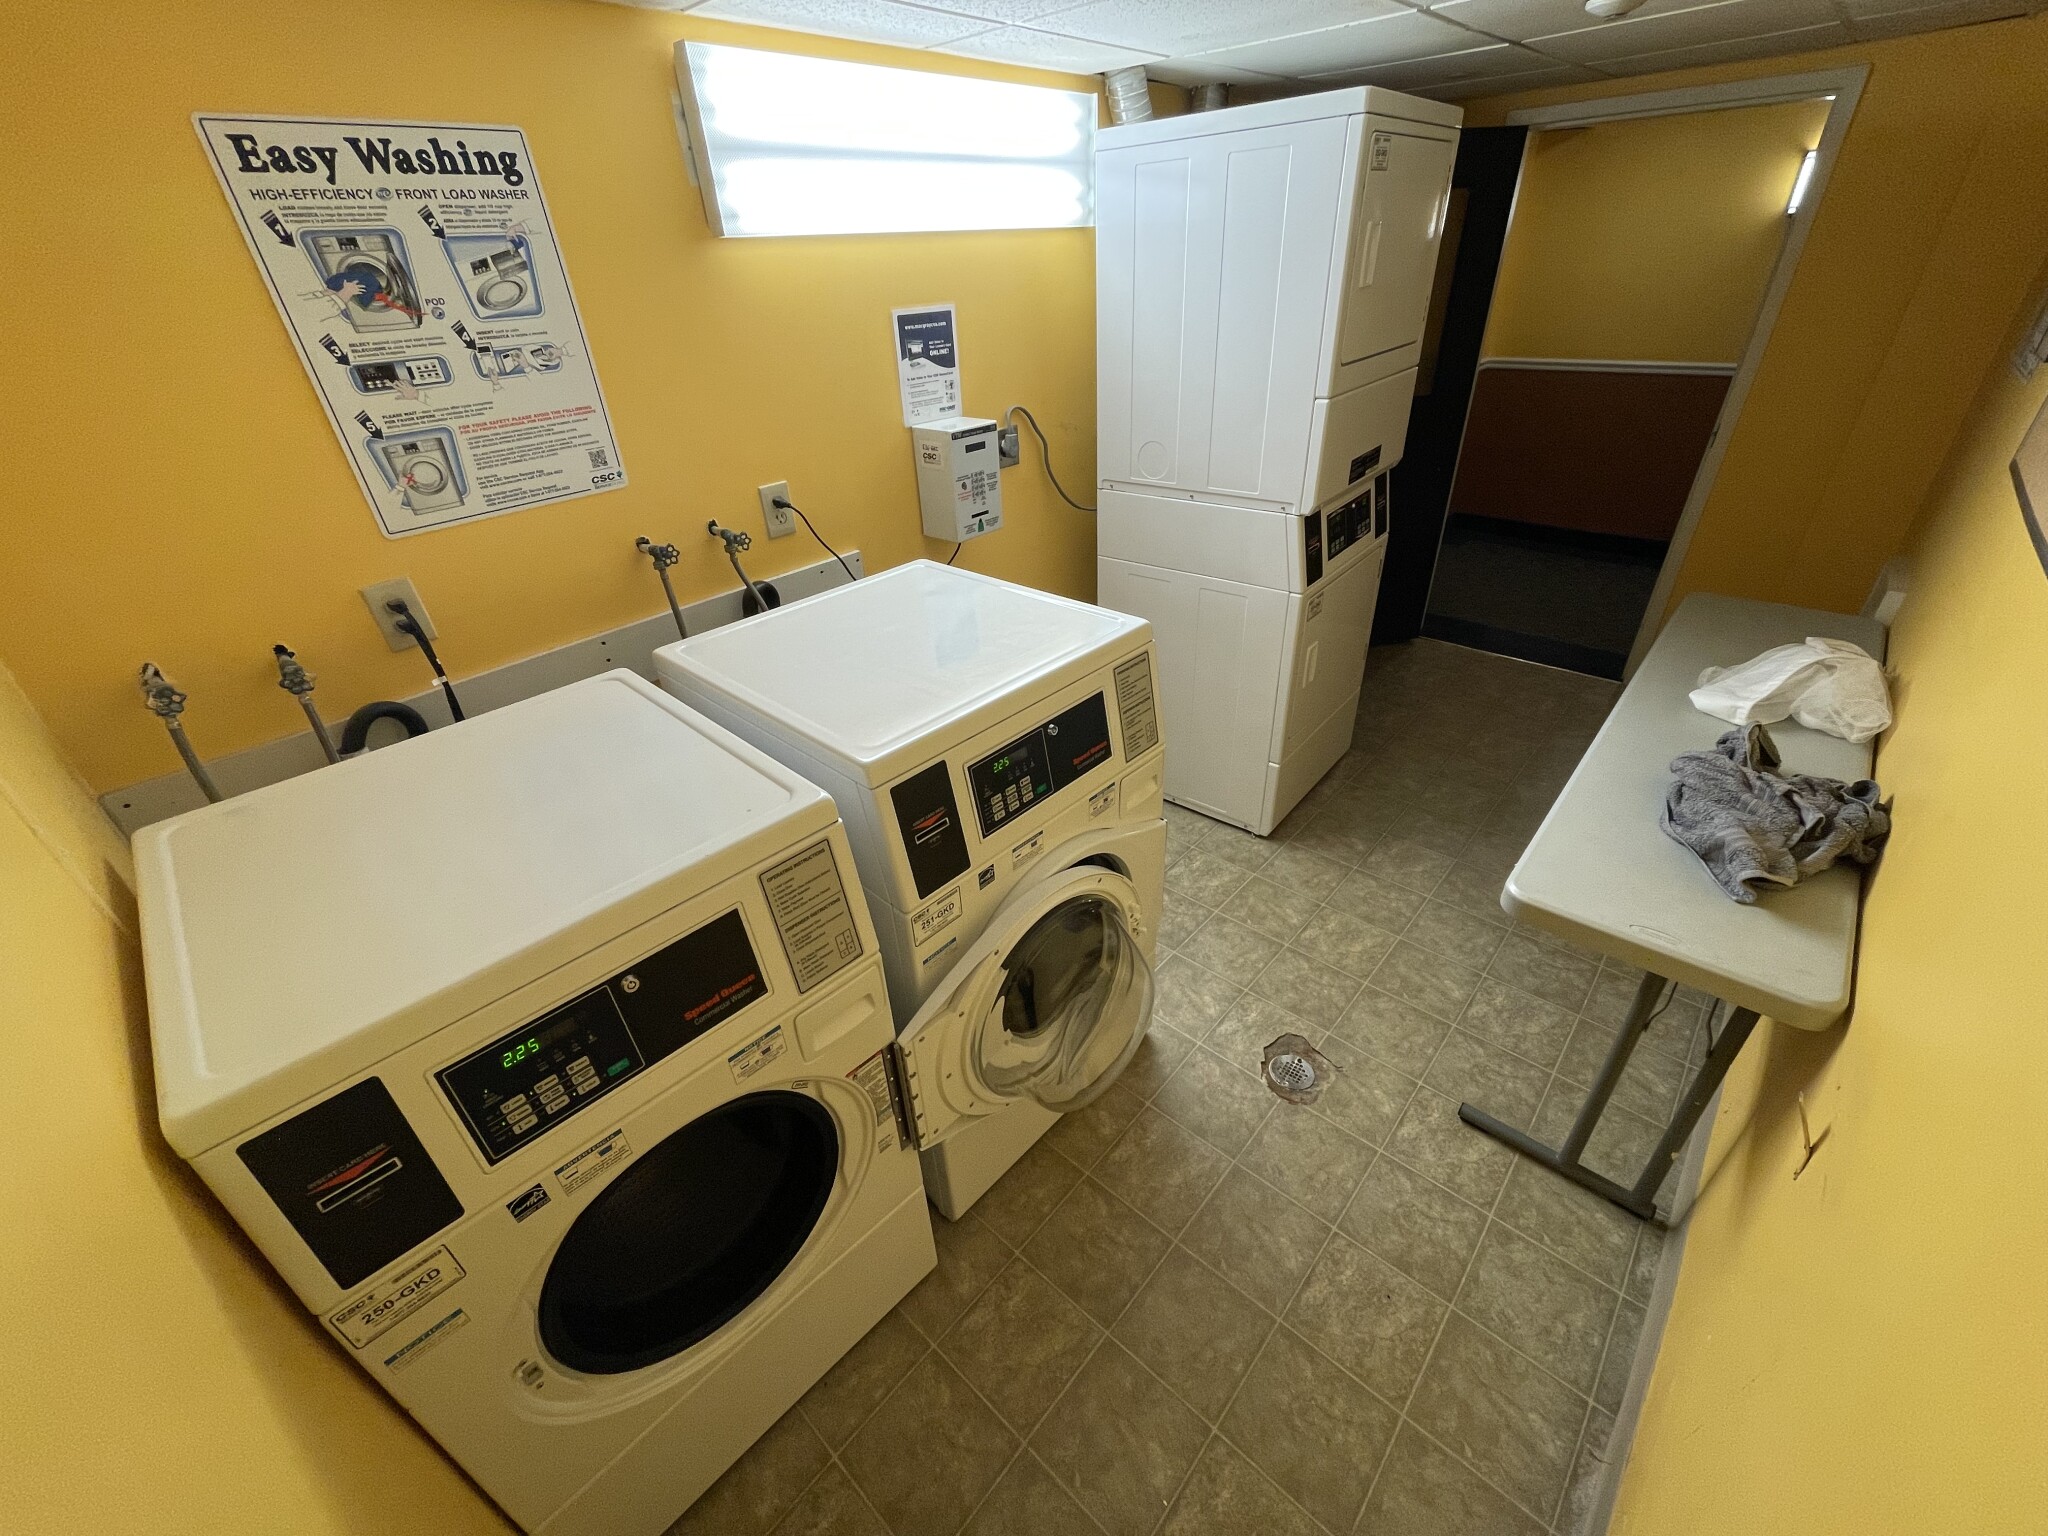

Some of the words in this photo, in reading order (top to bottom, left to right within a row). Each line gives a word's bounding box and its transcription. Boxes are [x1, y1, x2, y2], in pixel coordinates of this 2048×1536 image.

[225, 134, 338, 185] Easy
[343, 137, 524, 186] Washing
[249, 188, 373, 200] HIGH-EFFICIENCY
[395, 188, 438, 200] FRONT
[442, 189, 477, 200] LOAD
[478, 189, 530, 200] WASHER
[428, 218, 439, 230] 2
[424, 297, 446, 306] POD
[461, 331, 470, 342] 4
[330, 345, 341, 357] 3
[365, 421, 376, 432] 5
[458, 423, 471, 431] FOR
[471, 421, 488, 429] YOUR
[489, 418, 510, 426] SAFETY
[512, 414, 533, 422] PLEASE
[534, 411, 550, 419] AVOID
[922, 452, 937, 461] CSC
[591, 472, 616, 484] CSC
[766, 864, 794, 883] OPERATING
[793, 847, 826, 869] INSTRUCTIONS
[919, 902, 955, 930] 251-GKD
[683, 994, 720, 1021] Speed
[720, 973, 756, 998] Queen
[694, 999, 731, 1025] Commercial
[730, 986, 753, 1003] Washer
[502, 1038, 541, 1069] 2.25
[561, 1133, 615, 1171] ADVERTENCIA
[338, 1155, 363, 1172] CARD
[361, 1267, 442, 1325] 250-GKD
[335, 1300, 366, 1322] CSC
